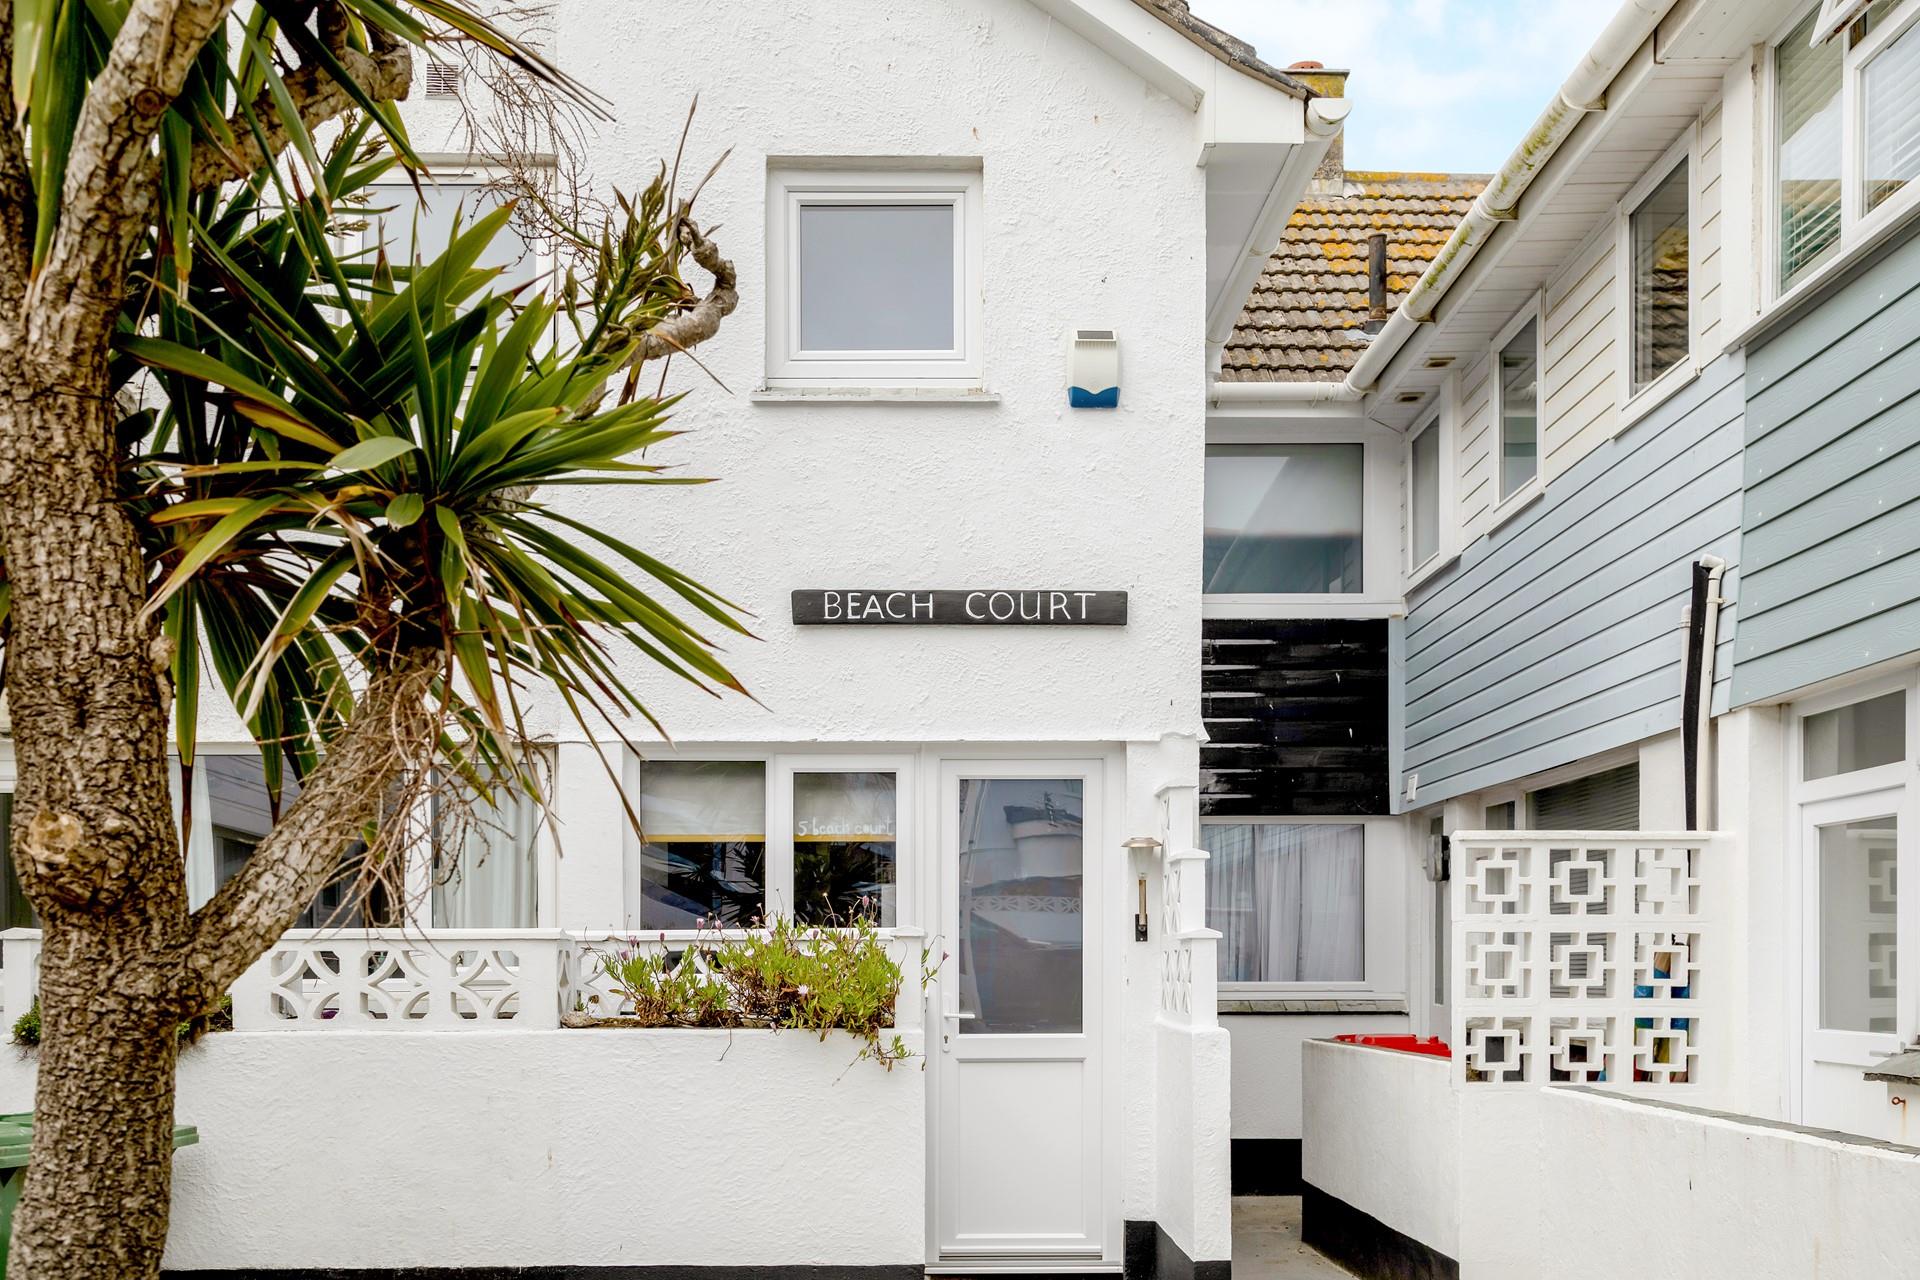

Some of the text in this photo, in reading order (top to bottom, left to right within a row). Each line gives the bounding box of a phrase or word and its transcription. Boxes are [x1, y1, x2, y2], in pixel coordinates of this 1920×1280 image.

[823, 591, 1097, 620] BEACH COURT
[798, 815, 894, 836] 5 beach court
